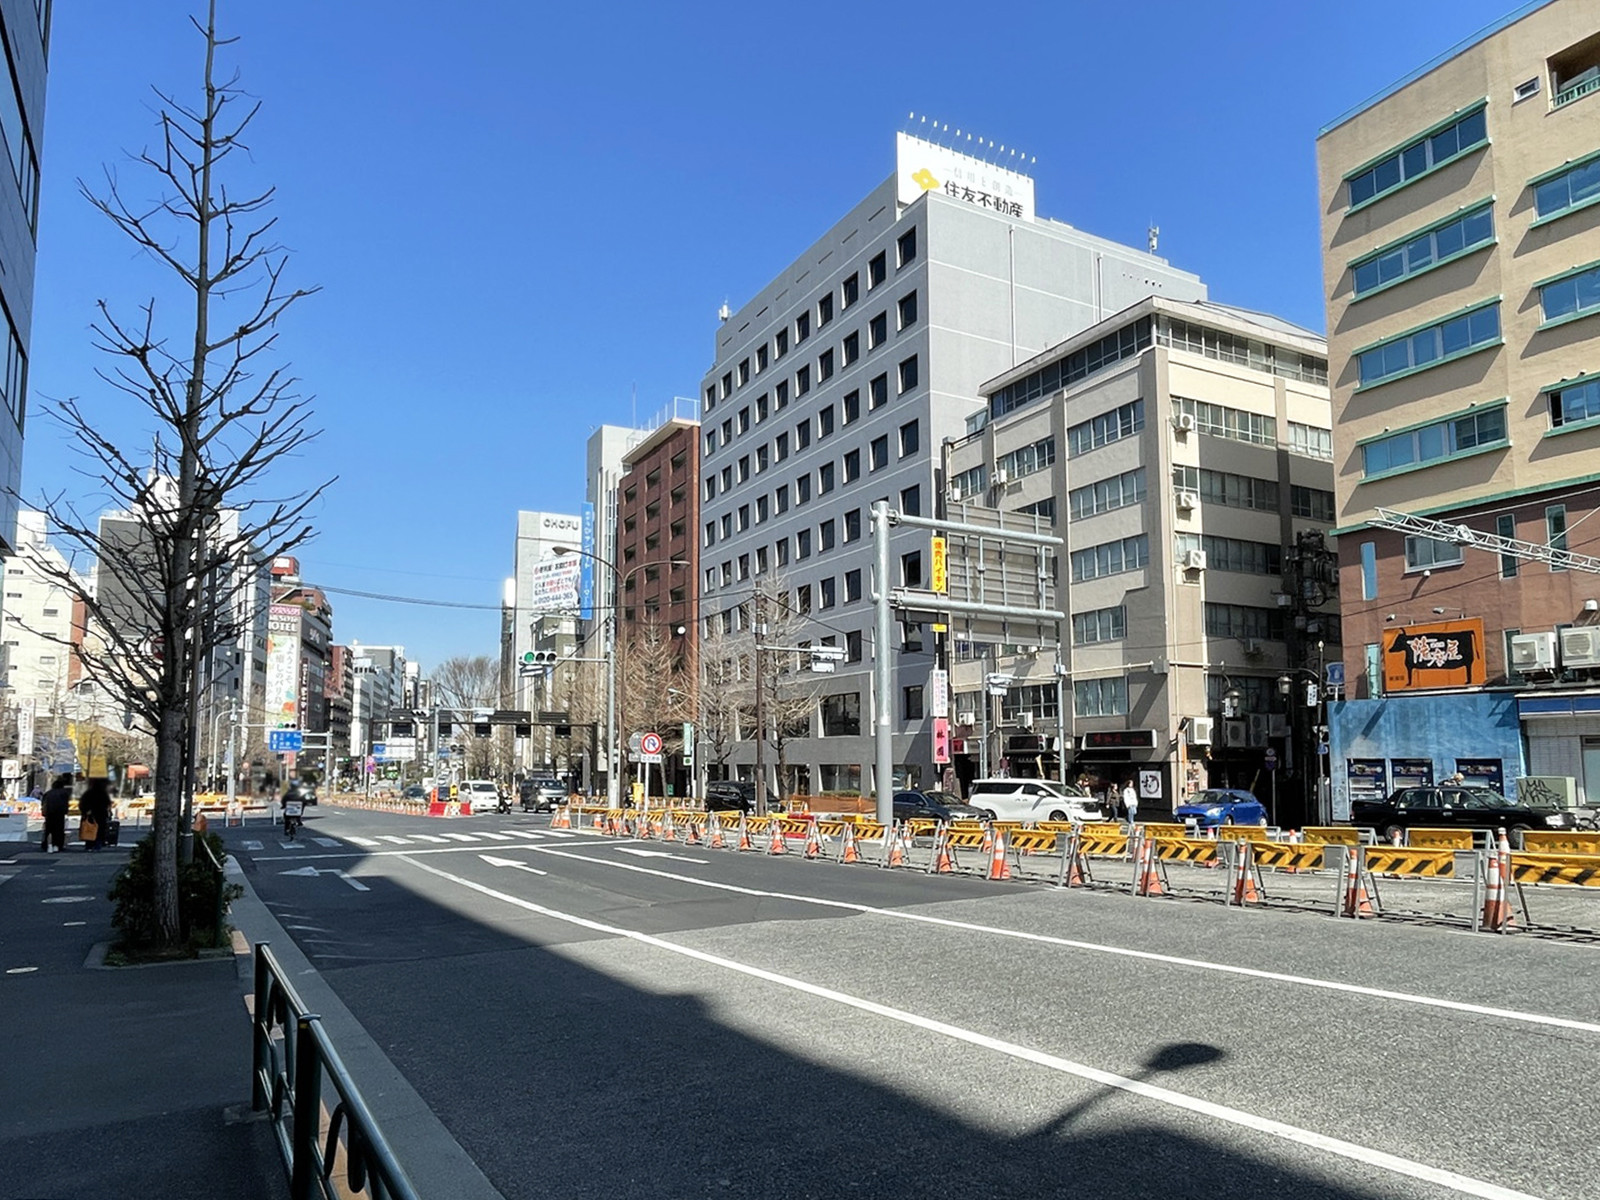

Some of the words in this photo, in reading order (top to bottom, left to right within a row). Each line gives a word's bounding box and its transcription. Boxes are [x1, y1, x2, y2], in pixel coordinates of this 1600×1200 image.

[944, 180, 1023, 217] 住友不動産
